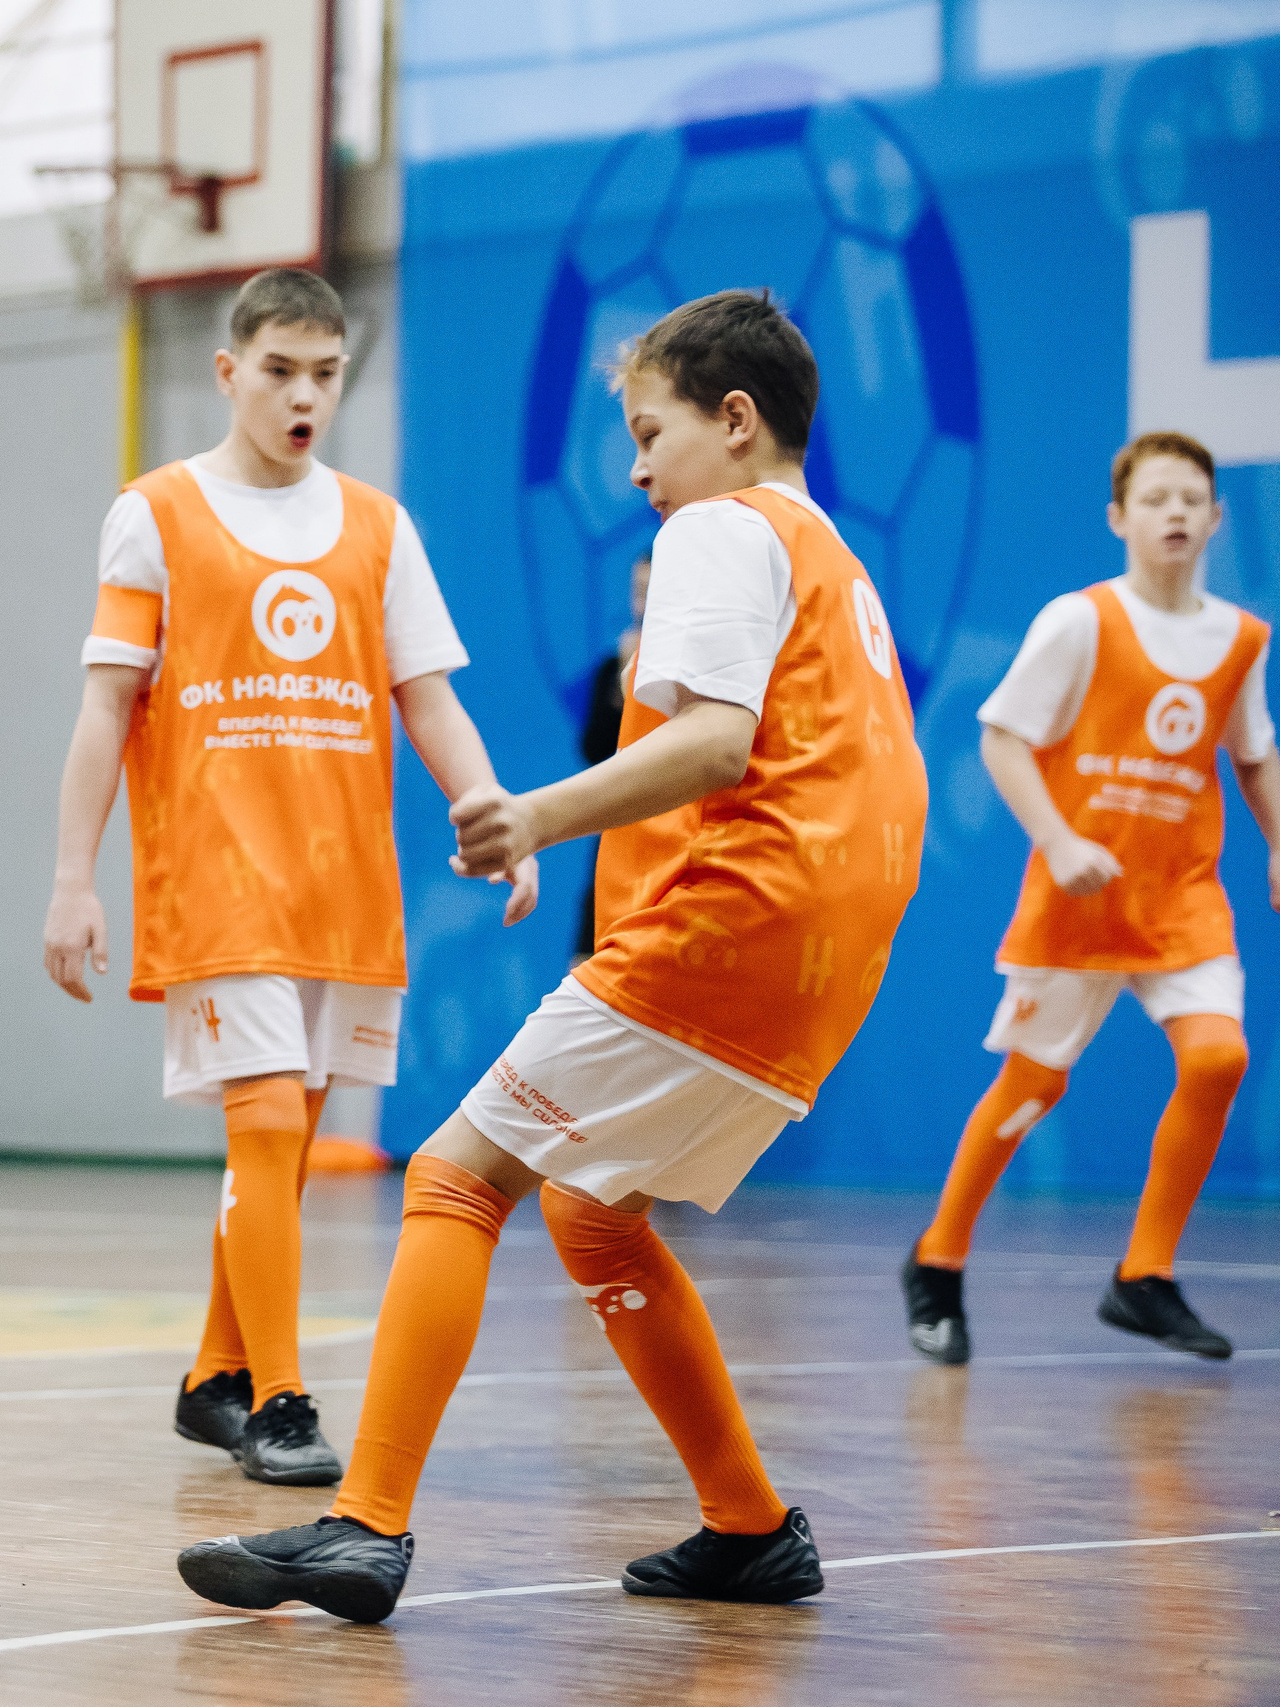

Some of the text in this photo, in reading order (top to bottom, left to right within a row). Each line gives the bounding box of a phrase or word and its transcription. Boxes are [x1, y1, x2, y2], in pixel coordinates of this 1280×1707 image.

[179, 679, 225, 710] ФК
[518, 1080, 529, 1091] К
[510, 1090, 533, 1110] МЫ
